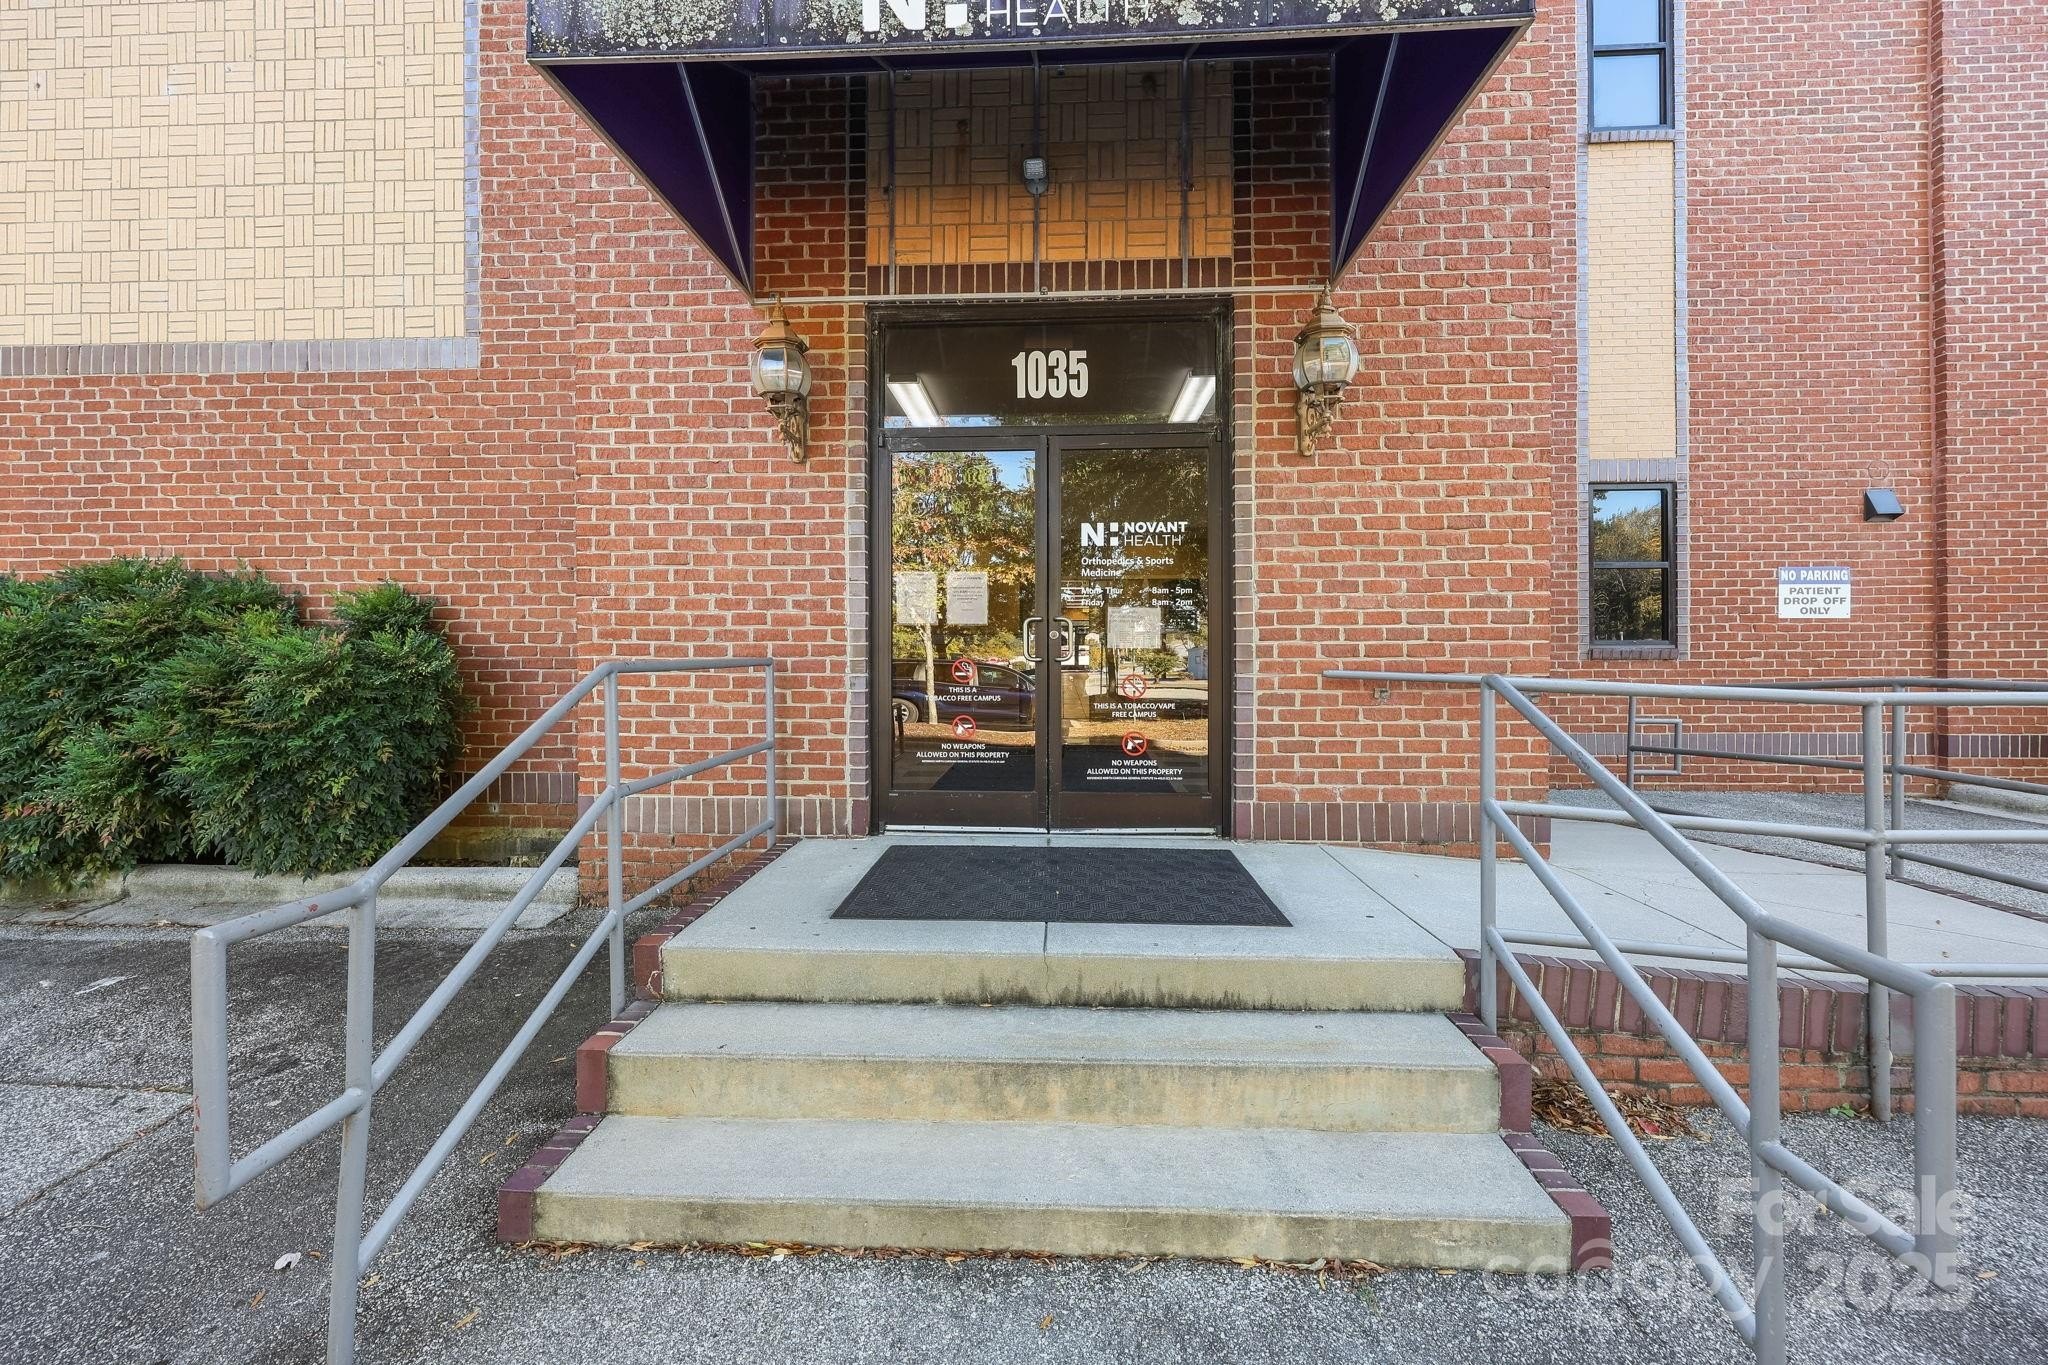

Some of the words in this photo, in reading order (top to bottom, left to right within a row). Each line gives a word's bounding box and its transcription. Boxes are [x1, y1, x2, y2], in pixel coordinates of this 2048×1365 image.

[1011, 350, 1089, 399] 1035
[1123, 521, 1188, 533] NOVANT
[1124, 534, 1182, 546] HEALTH
[1081, 557, 1135, 566] Orthopedics
[1137, 557, 1144, 565] &
[1145, 557, 1174, 566] Sports
[1081, 569, 1121, 577] Medicine
[1780, 569, 1797, 581] NO
[1800, 569, 1849, 581] PARKING
[1105, 586, 1124, 594] Thur
[1175, 587, 1193, 595] 5pm
[1789, 587, 1841, 595] PATIENT
[1081, 599, 1105, 607] Friday
[1175, 599, 1193, 607] 2pm
[1783, 597, 1818, 605] DROP
[1823, 597, 1847, 605] OFF
[1799, 607, 1831, 615] ONLY
